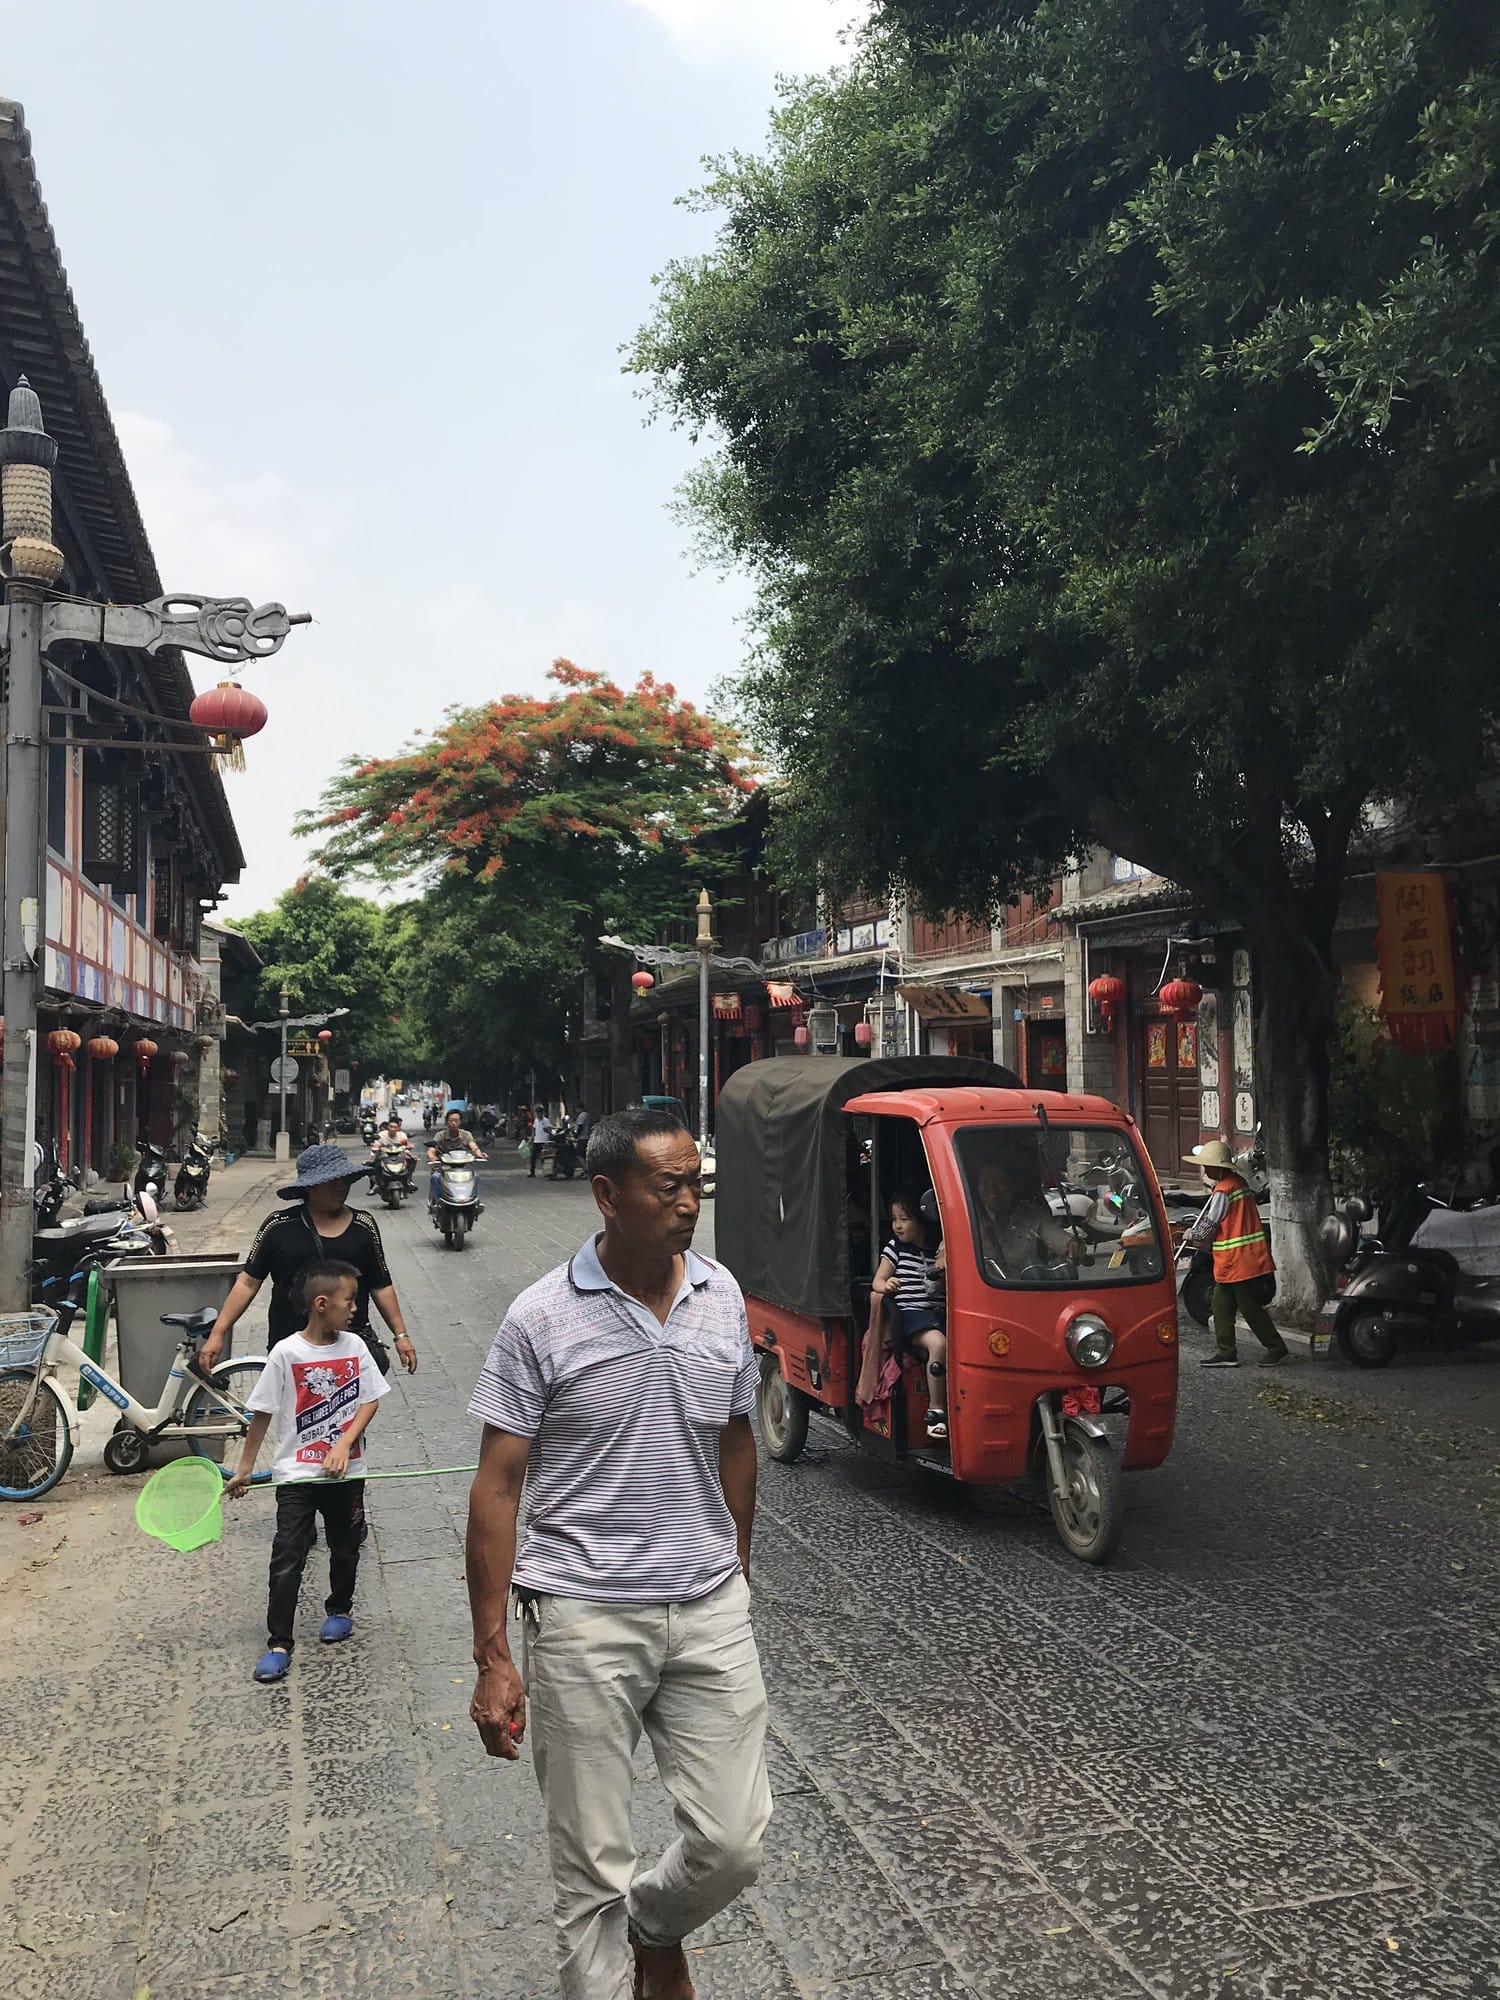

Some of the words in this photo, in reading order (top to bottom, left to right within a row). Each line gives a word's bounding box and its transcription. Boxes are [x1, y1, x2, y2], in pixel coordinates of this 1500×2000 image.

[344, 1360, 356, 1379] 3
[301, 1413, 312, 1428] THE
[312, 1404, 329, 1421] THREE
[328, 1392, 344, 1413] LITTLE
[344, 1382, 358, 1401] PIGS
[301, 1449, 326, 1461] 193
